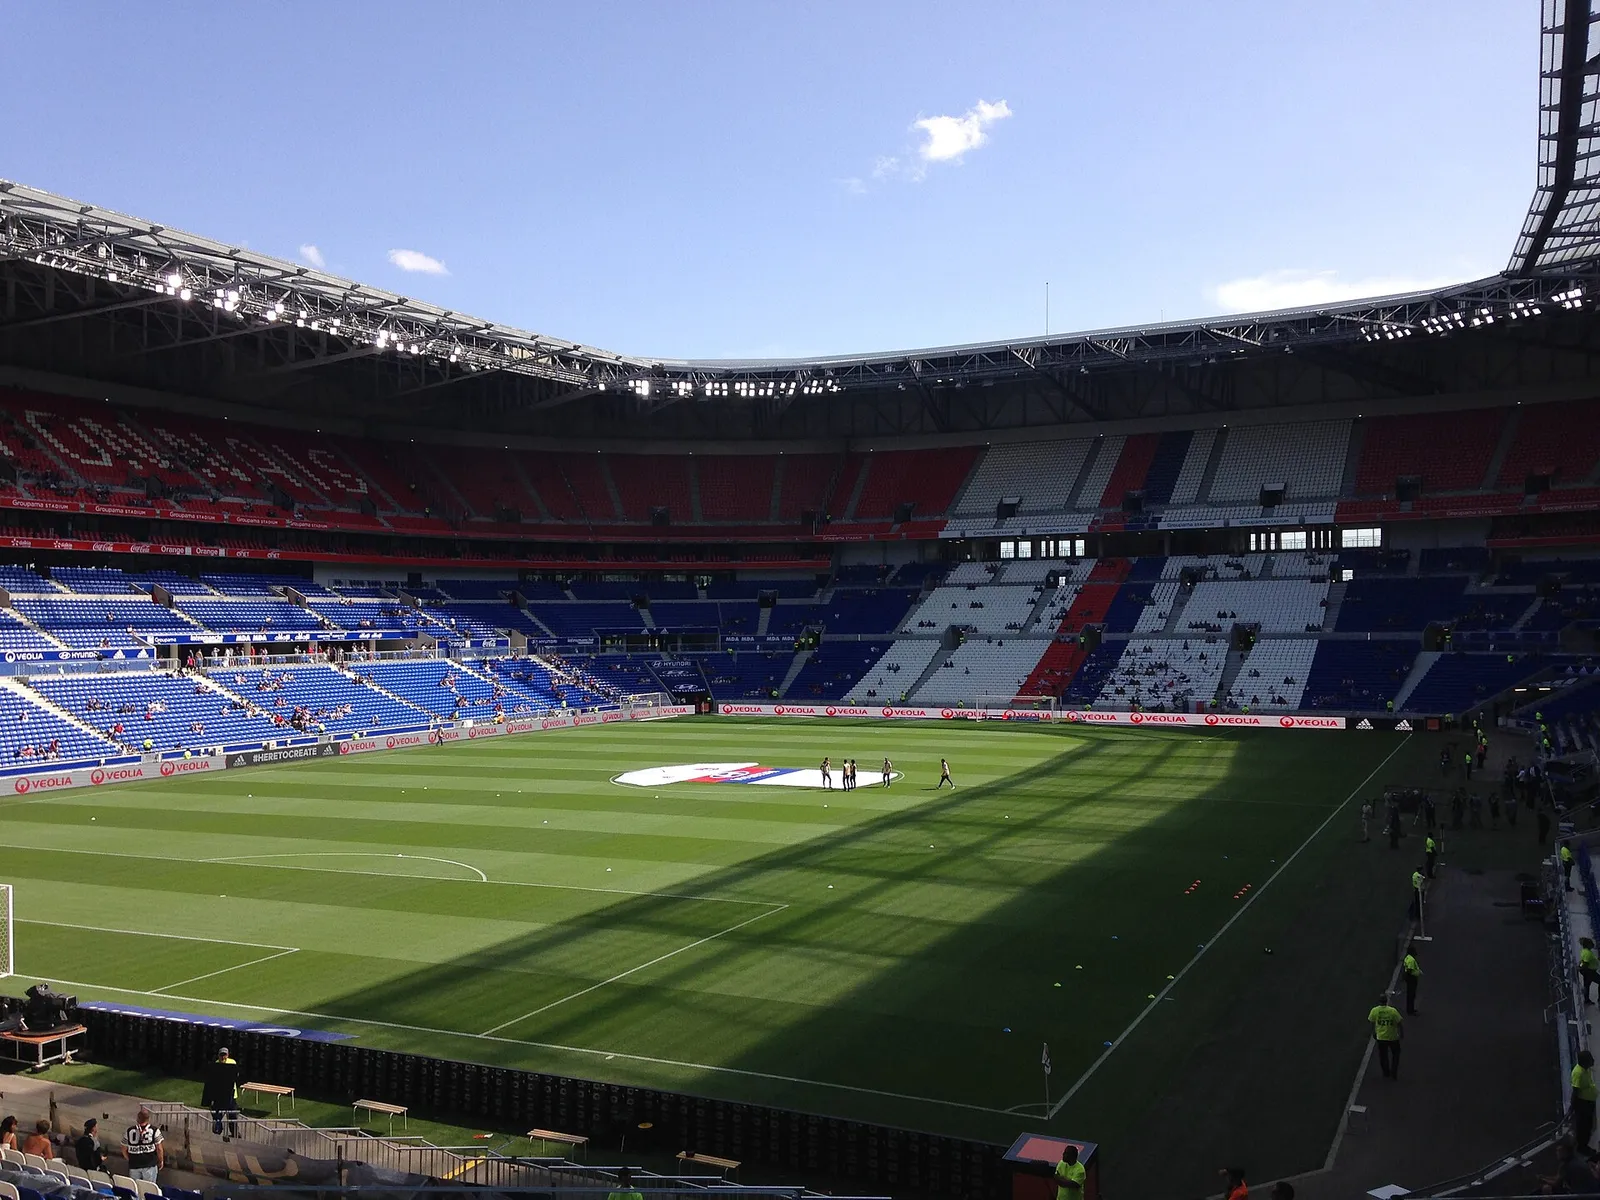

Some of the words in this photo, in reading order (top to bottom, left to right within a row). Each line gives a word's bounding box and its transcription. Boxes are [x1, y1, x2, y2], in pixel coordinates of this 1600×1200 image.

[12, 499, 44, 509] Groupama
[95, 505, 124, 514] Groupama
[169, 511, 195, 519] Groupama
[236, 517, 260, 525] Groupama
[161, 545, 185, 554] Orange
[196, 547, 218, 555] Orange
[17, 652, 44, 660] VEOLIA
[1081, 713, 1117, 721] VEOLIA
[1296, 719, 1338, 727] VEOLIA
[477, 727, 497, 735] VEOLIA
[396, 736, 420, 745] VEOLIA
[350, 741, 376, 751] VEOLIA
[253, 748, 317, 762] #HERETOCREATE
[176, 760, 209, 772] VEOLIA
[107, 768, 143, 780] VEOLIA
[33, 776, 72, 788] VEOLIA
[128, 1127, 154, 1145] 03
